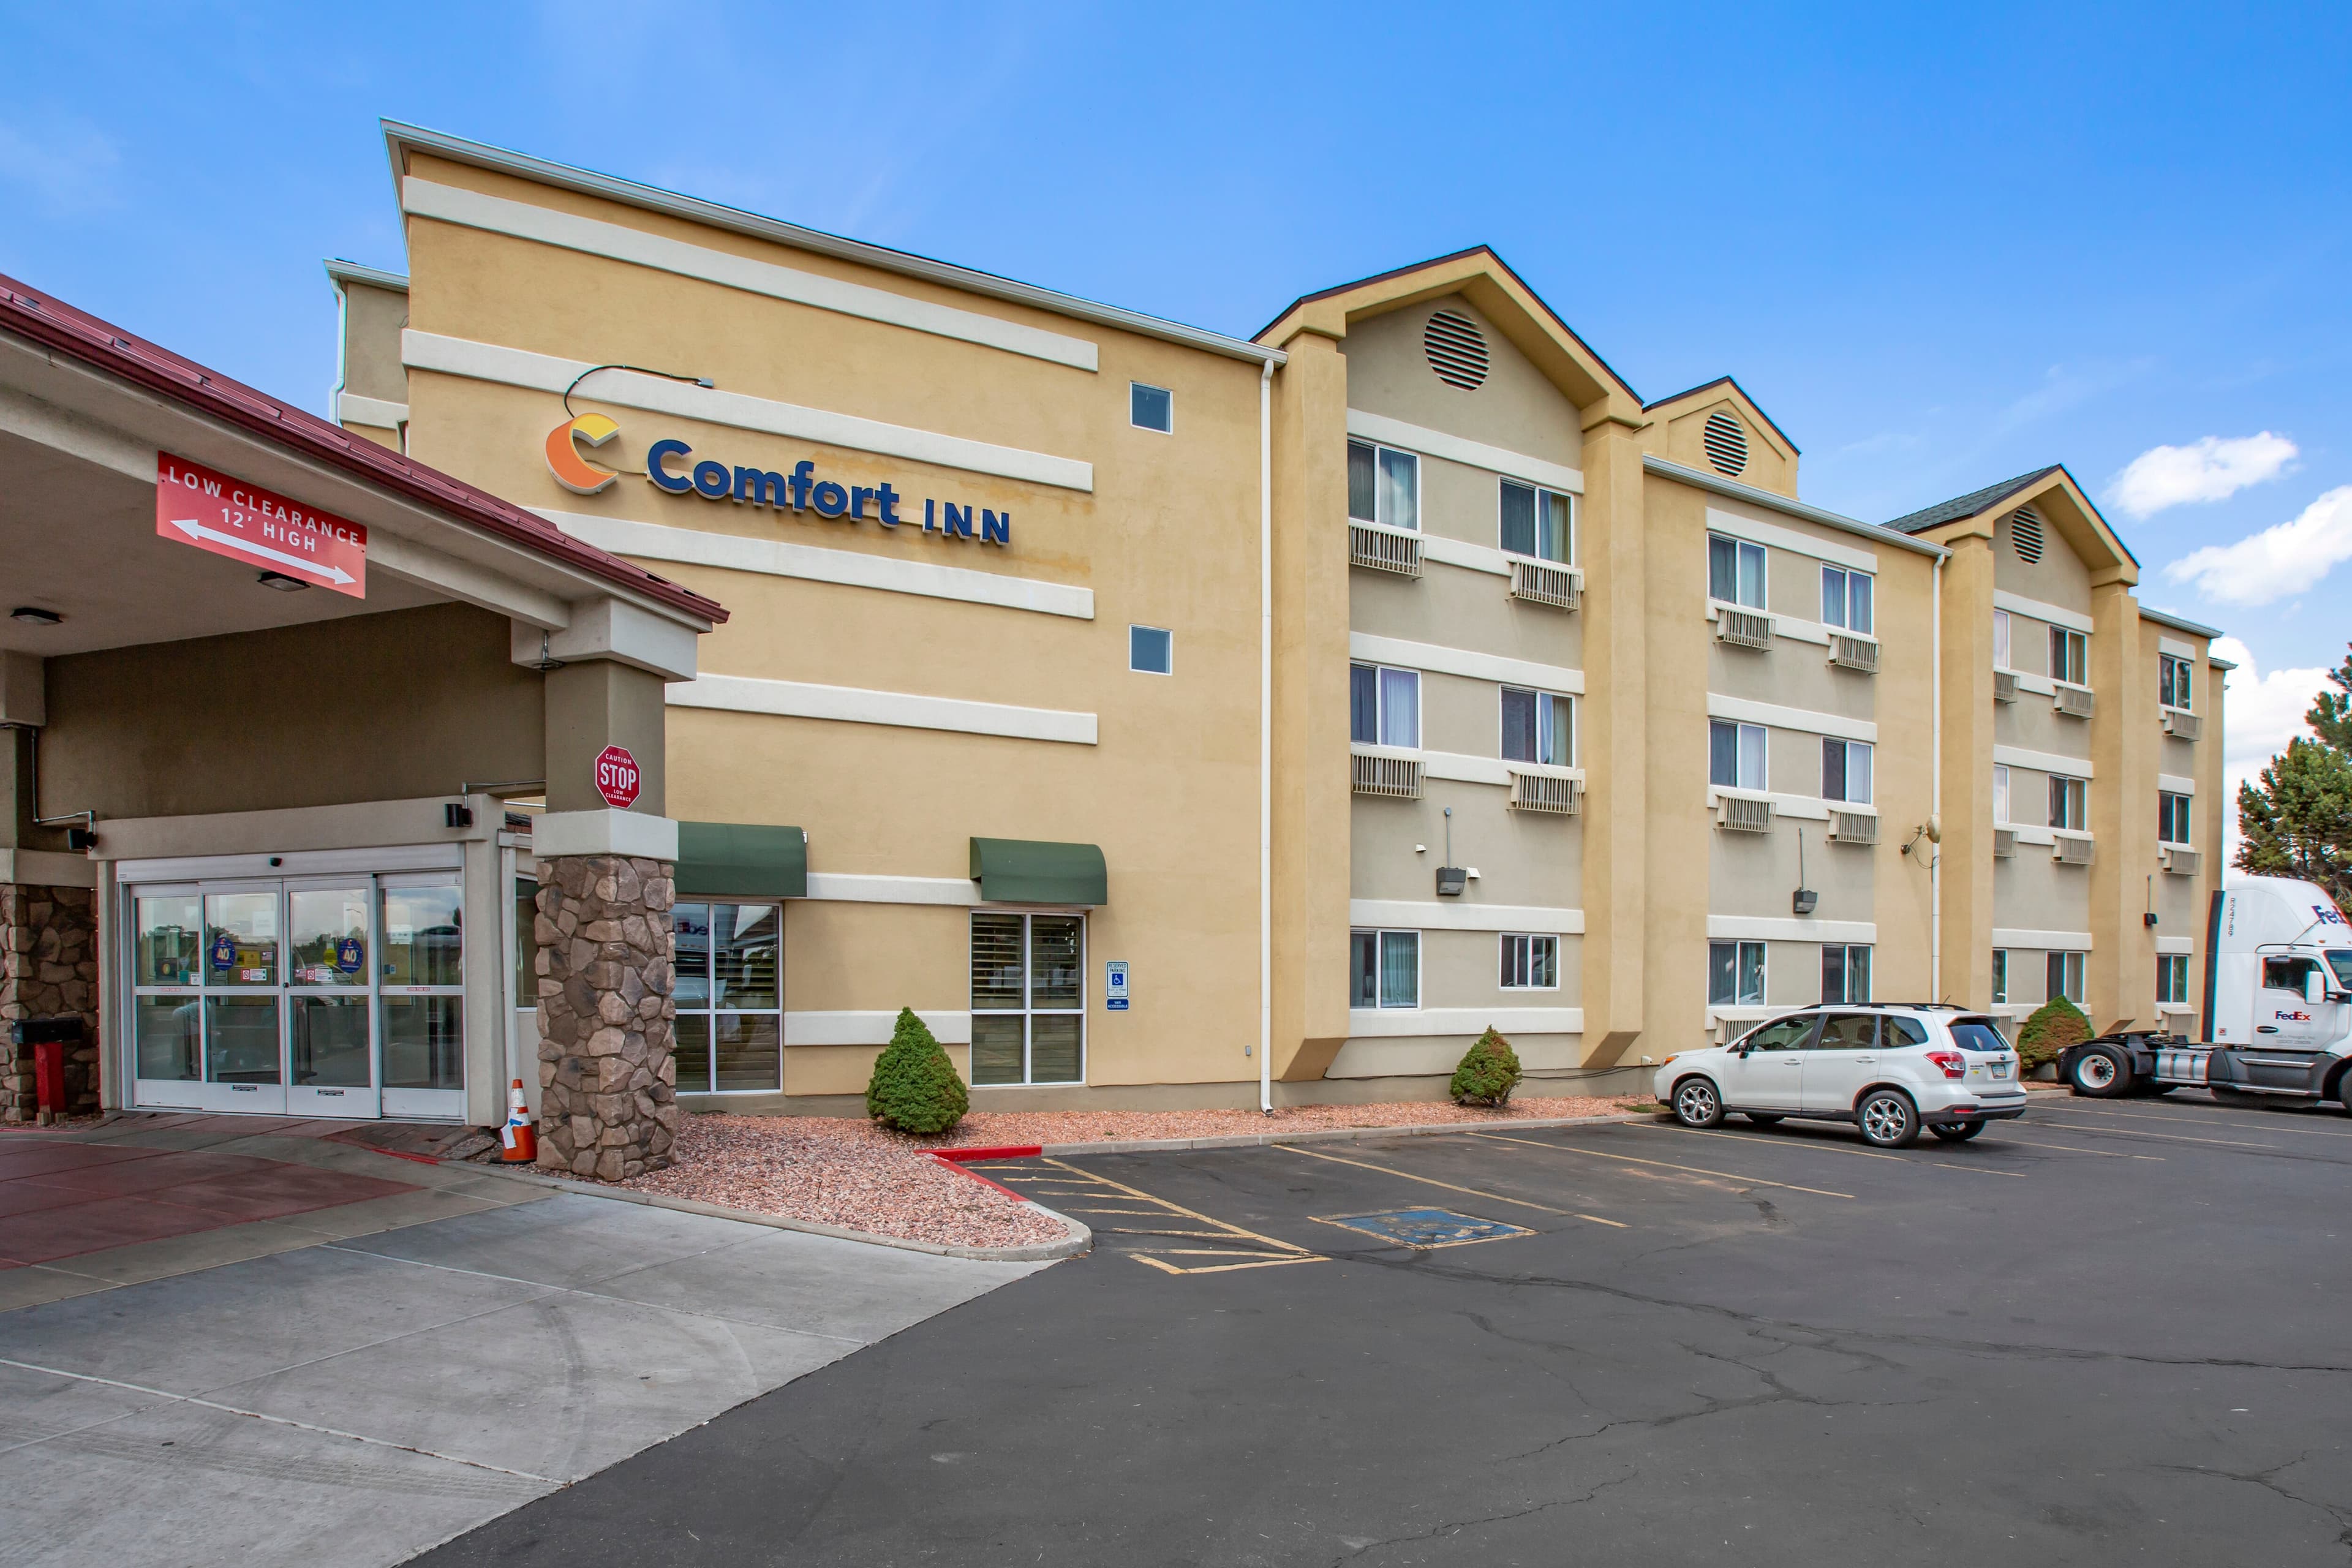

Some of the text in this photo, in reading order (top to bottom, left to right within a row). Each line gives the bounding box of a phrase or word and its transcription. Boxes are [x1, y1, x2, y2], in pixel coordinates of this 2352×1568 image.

[647, 439, 1010, 546] Comfort INN
[169, 466, 359, 547] LOW CLEARANCE
[221, 508, 315, 552] 12' HIGH
[605, 753, 631, 765] CAUTION
[600, 762, 636, 791] STOP
[605, 793, 631, 802] CLEARANCE
[216, 947, 230, 961] 40
[343, 948, 357, 963] 40
[2275, 1010, 2312, 1021] FedEx
